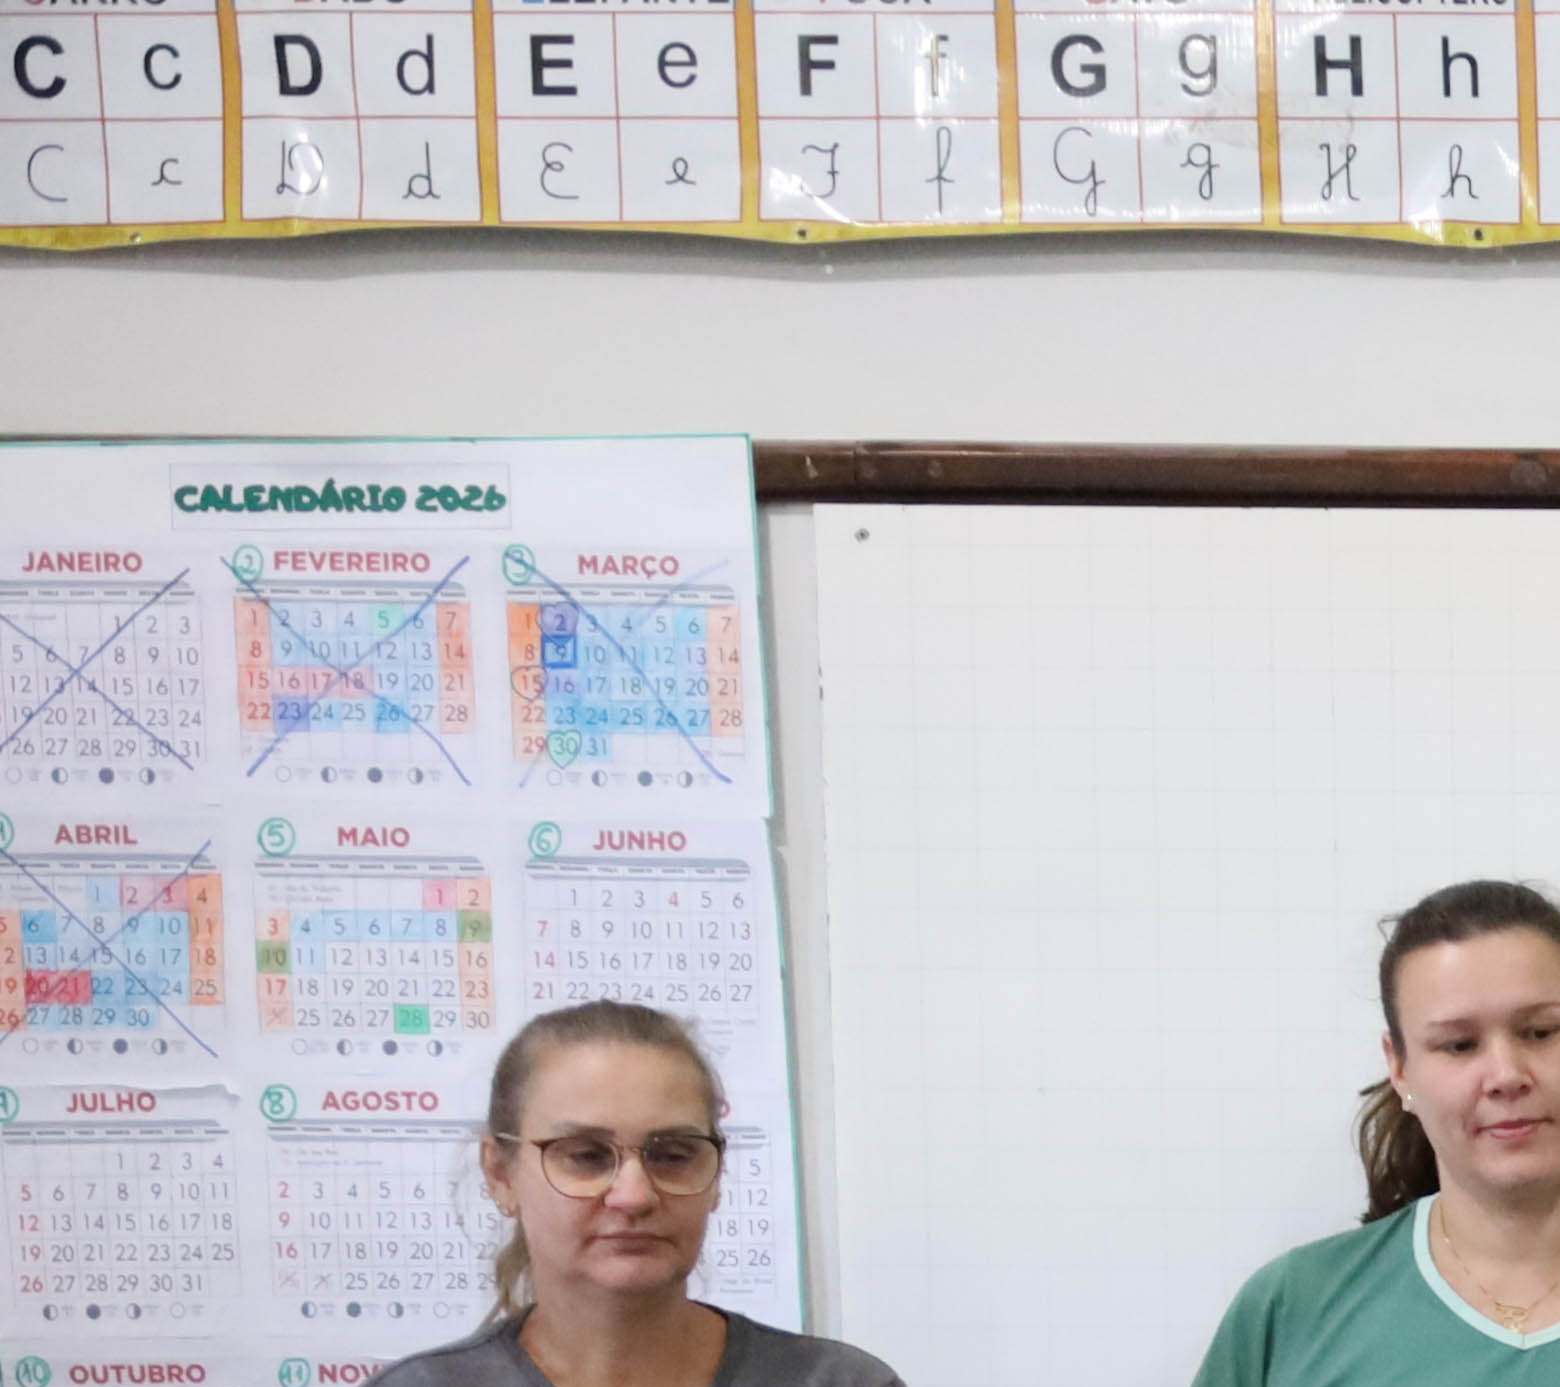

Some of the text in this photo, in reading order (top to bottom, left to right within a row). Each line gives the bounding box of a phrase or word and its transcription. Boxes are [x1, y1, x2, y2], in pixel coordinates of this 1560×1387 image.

[14, 35, 66, 99] C
[274, 34, 435, 96] D d
[530, 35, 697, 96] E e
[798, 35, 838, 96] F
[1051, 34, 1106, 97] G
[1314, 35, 1478, 97] H h
[174, 478, 506, 513] CALENDÁRIO 2026
[22, 552, 142, 572] JANEIRO
[274, 551, 430, 573] FEVEREIRO
[578, 555, 679, 579] MARÇO
[55, 824, 137, 845] ABRIL
[338, 827, 410, 847] MAIO
[593, 830, 686, 851] JUNHO
[67, 1090, 156, 1113] JULHO
[322, 1091, 439, 1112] AGOSTO
[69, 1364, 205, 1384] OUTUBRO
